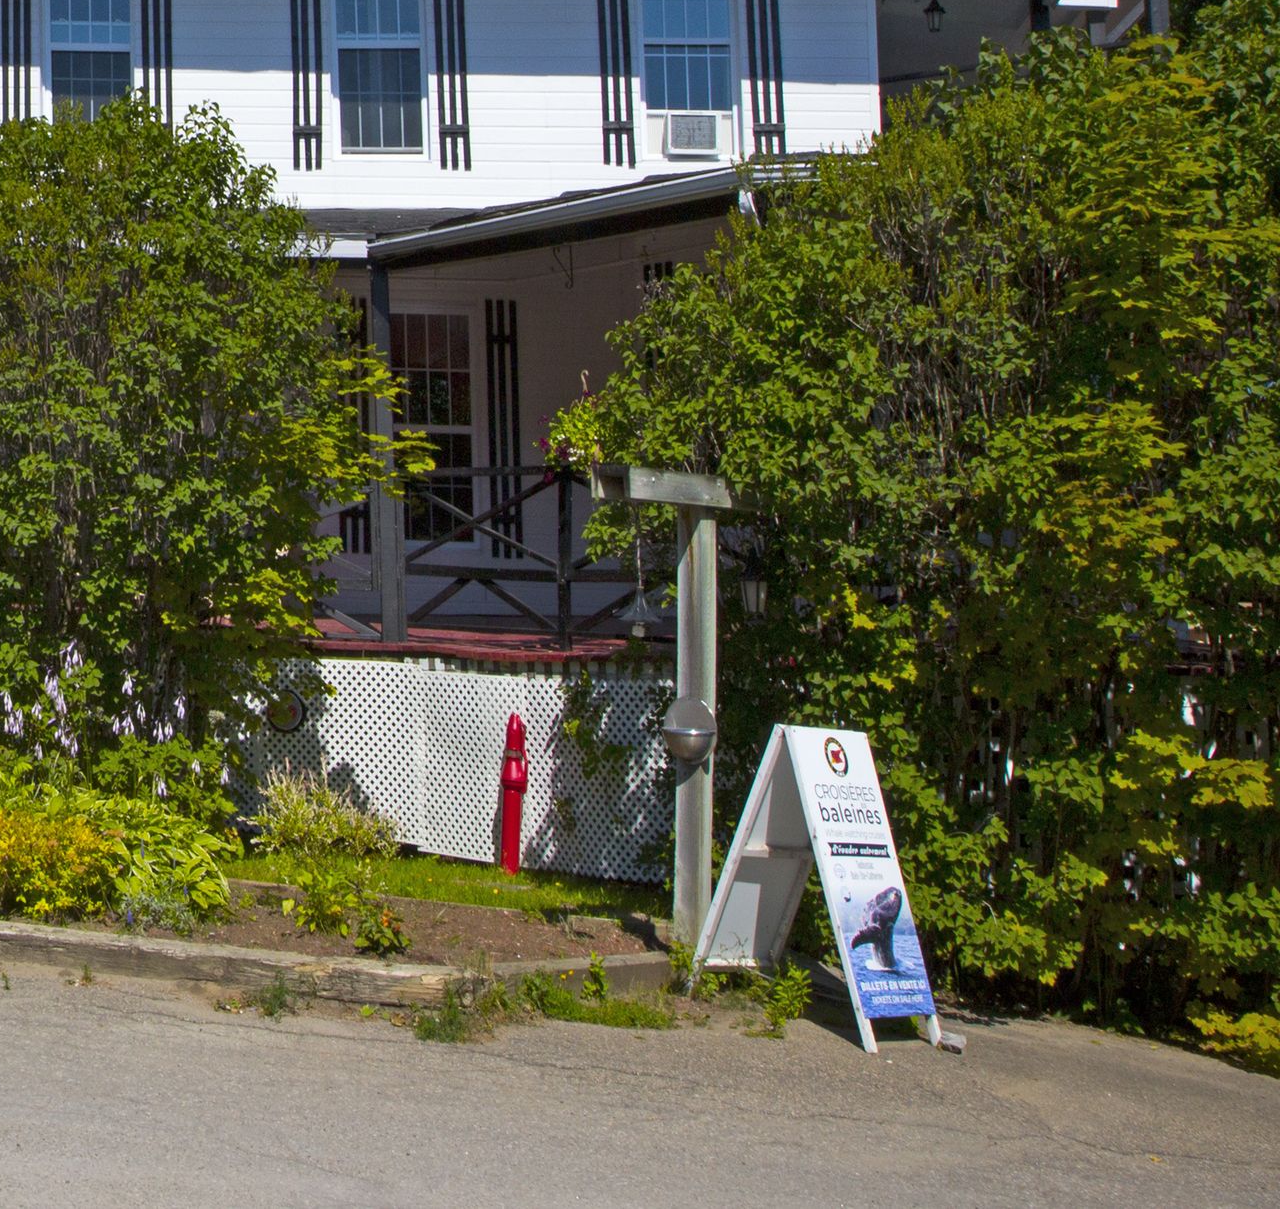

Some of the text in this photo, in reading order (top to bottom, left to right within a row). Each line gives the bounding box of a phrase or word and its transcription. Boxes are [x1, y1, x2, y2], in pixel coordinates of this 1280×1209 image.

[814, 782, 877, 802] CROISIÈRES
[817, 801, 882, 825] baleines
[860, 981, 888, 991] BILLETS
